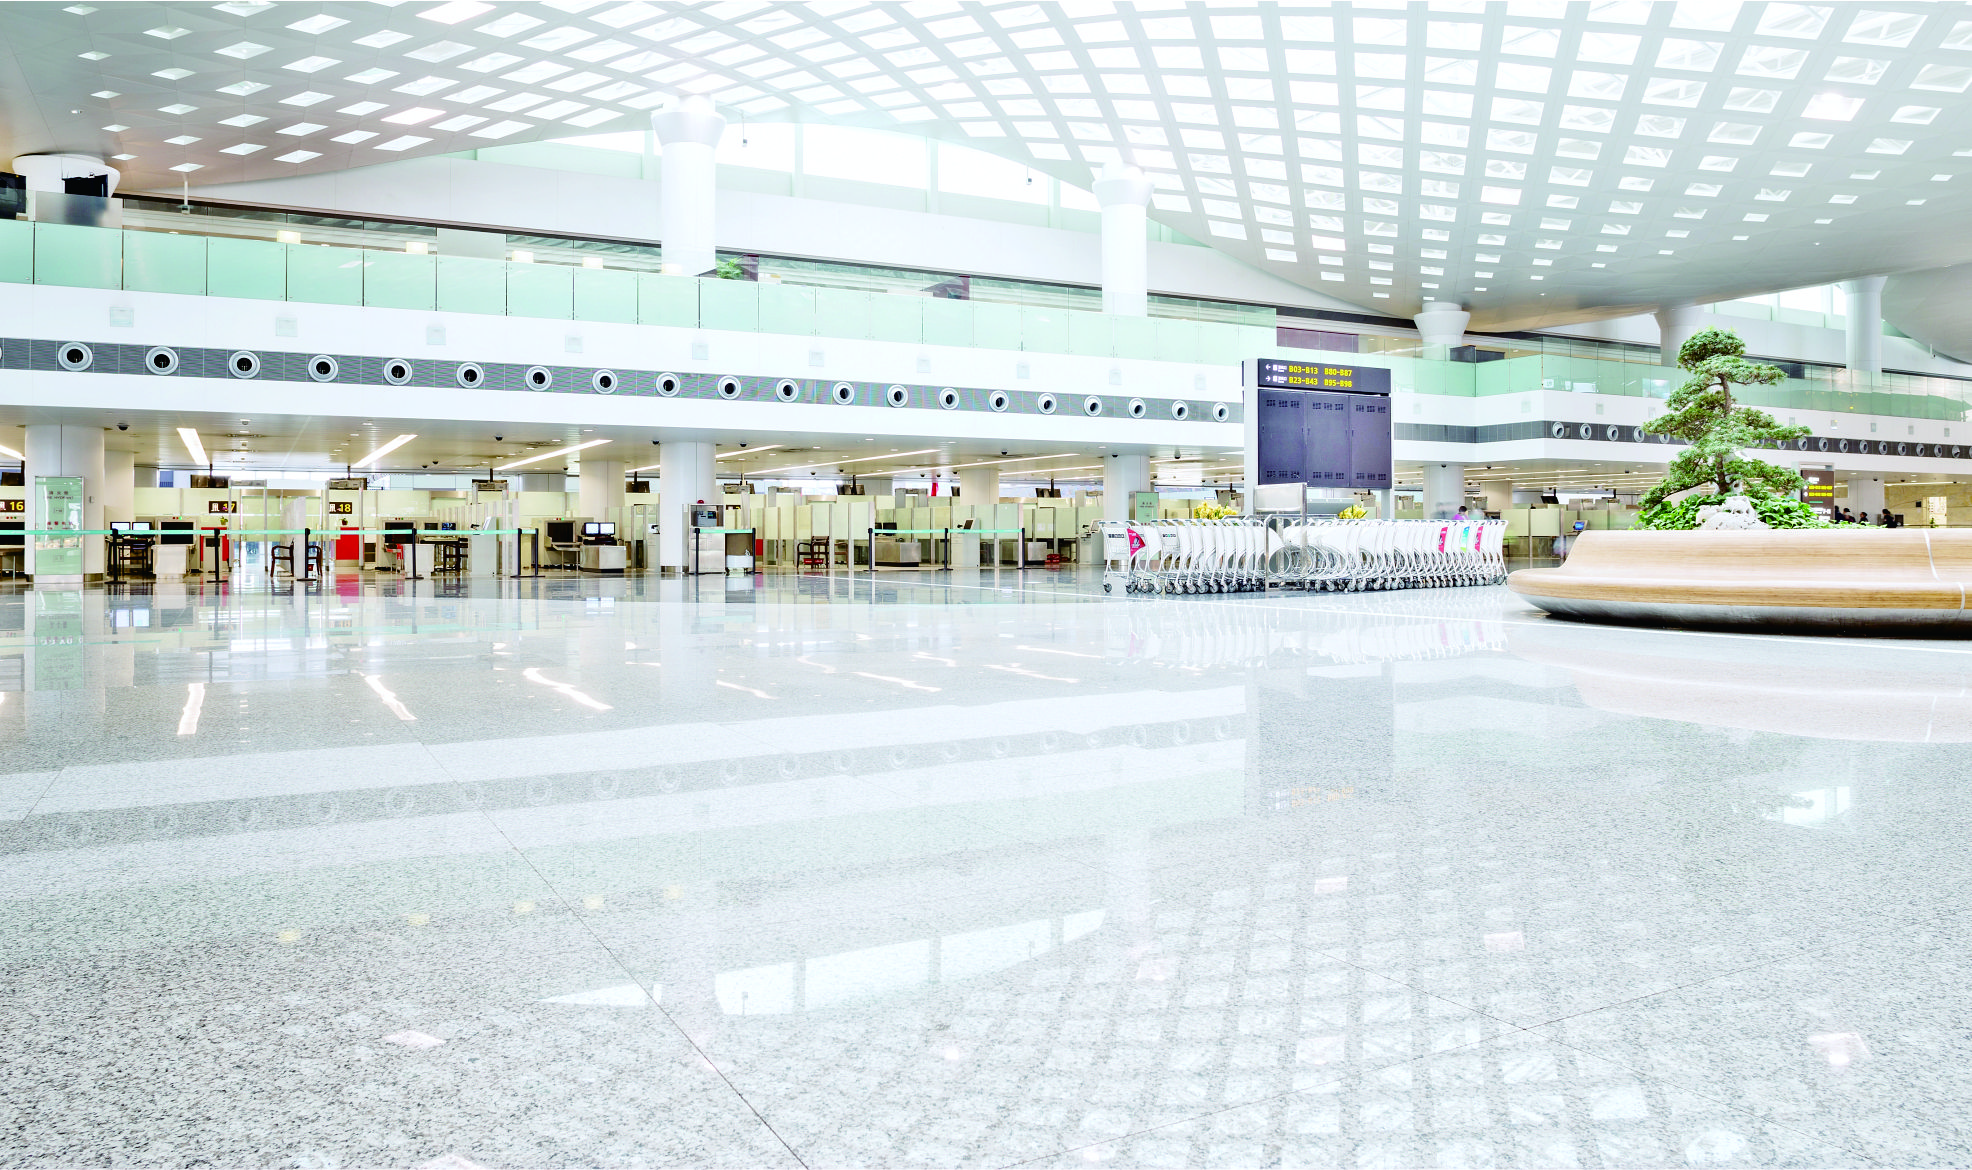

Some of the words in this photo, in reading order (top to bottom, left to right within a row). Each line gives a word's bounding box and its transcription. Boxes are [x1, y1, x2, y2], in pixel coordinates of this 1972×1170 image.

[1288, 365, 1318, 375] B03-B13
[1324, 367, 1353, 377] B80-B87
[1288, 376, 1318, 386] B23-B43
[9, 501, 24, 511] 16
[222, 502, 236, 512] 17
[339, 503, 352, 513] 18
